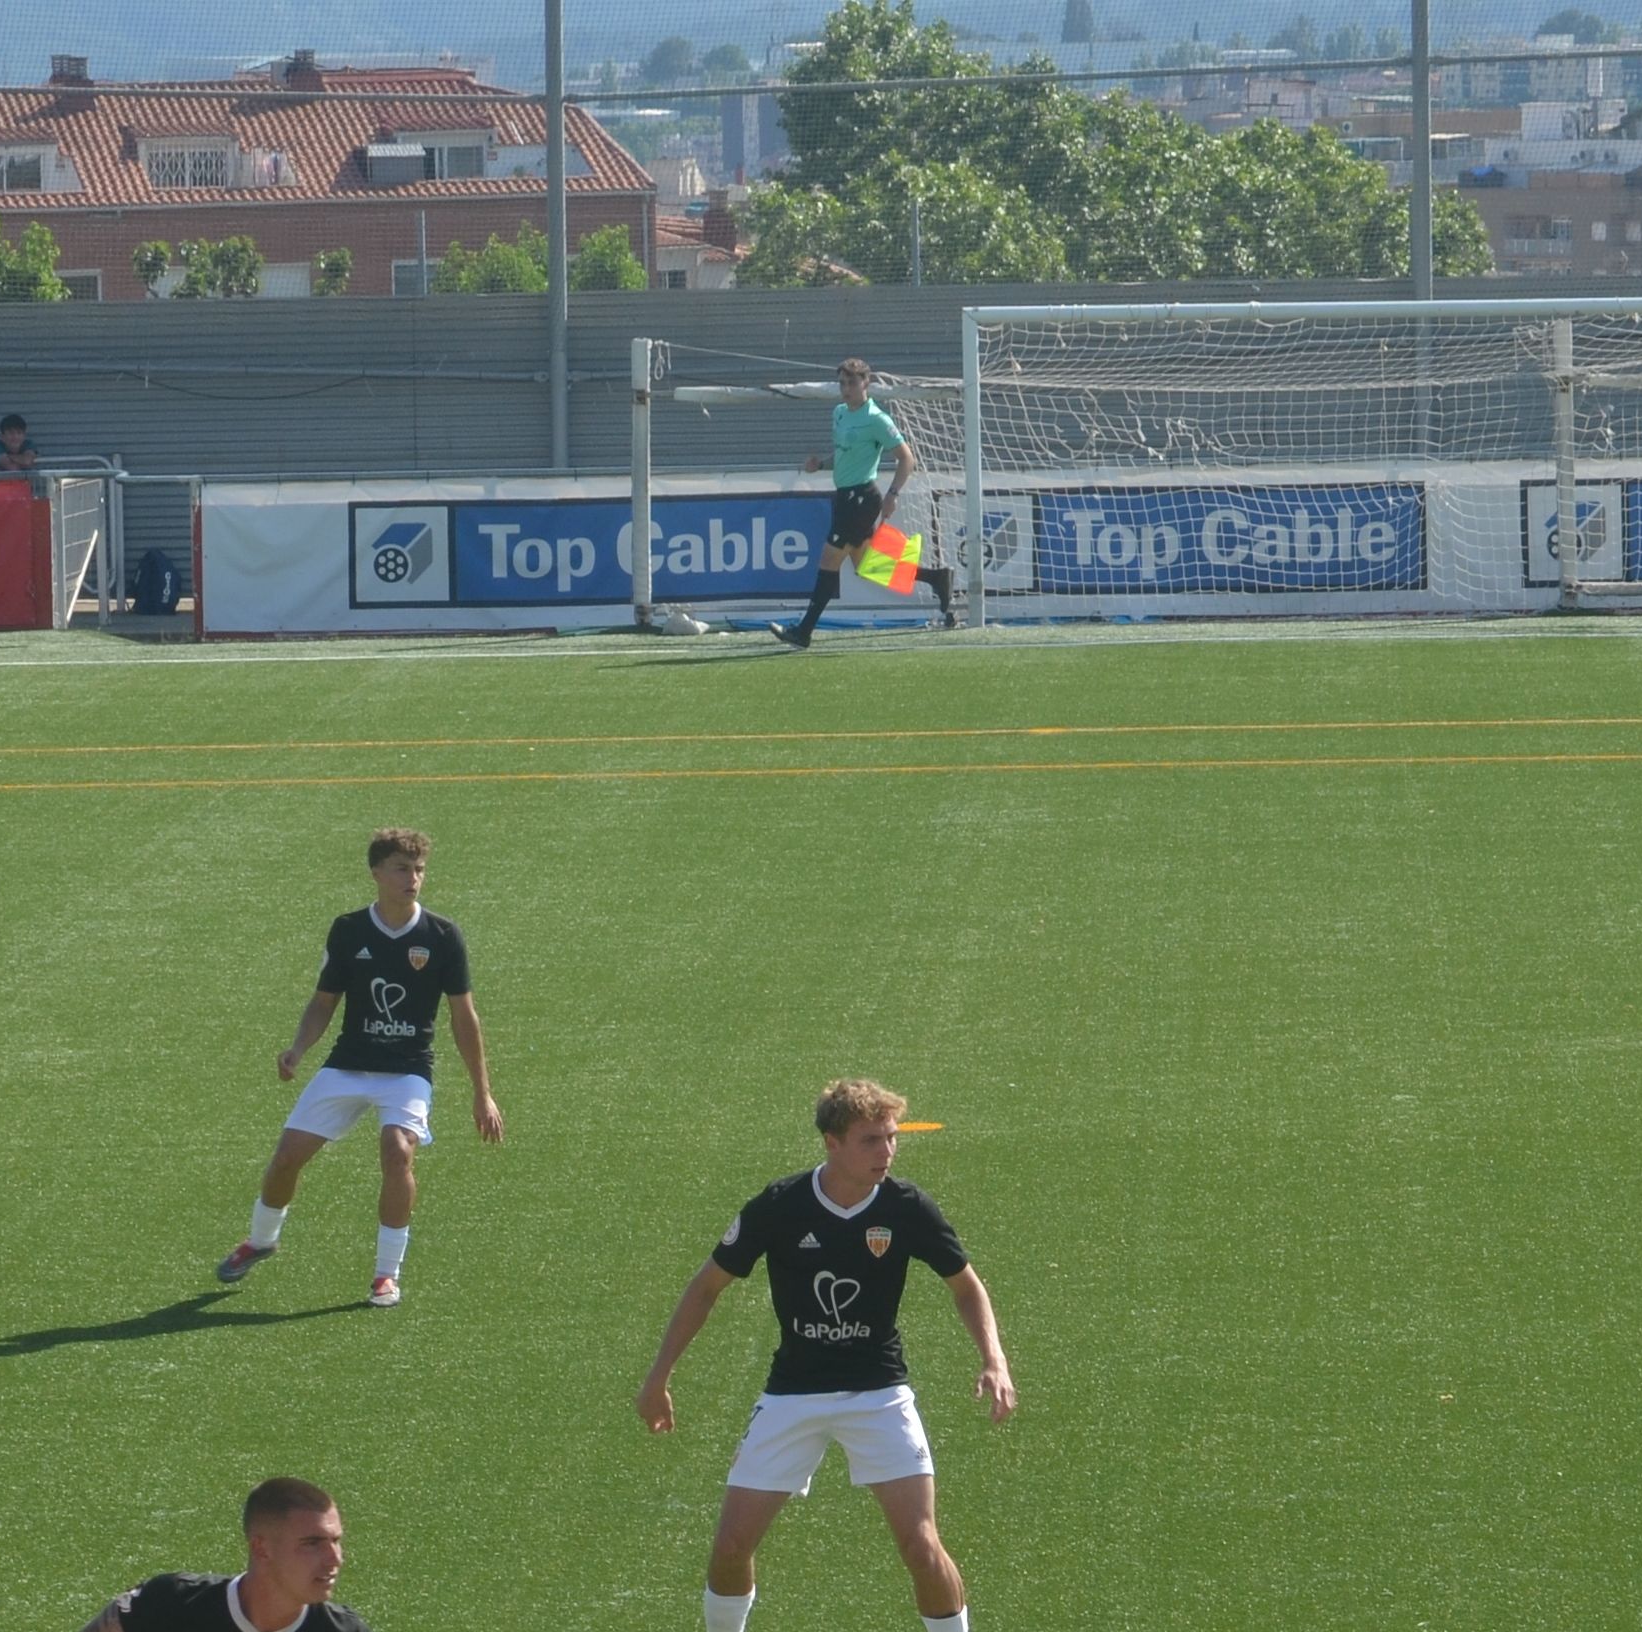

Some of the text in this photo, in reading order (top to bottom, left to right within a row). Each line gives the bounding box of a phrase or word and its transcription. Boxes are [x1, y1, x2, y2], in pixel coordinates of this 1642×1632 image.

[478, 516, 809, 592] Top Cable
[1063, 505, 1396, 580] Top Cable
[794, 1317, 871, 1341] LaPobla
